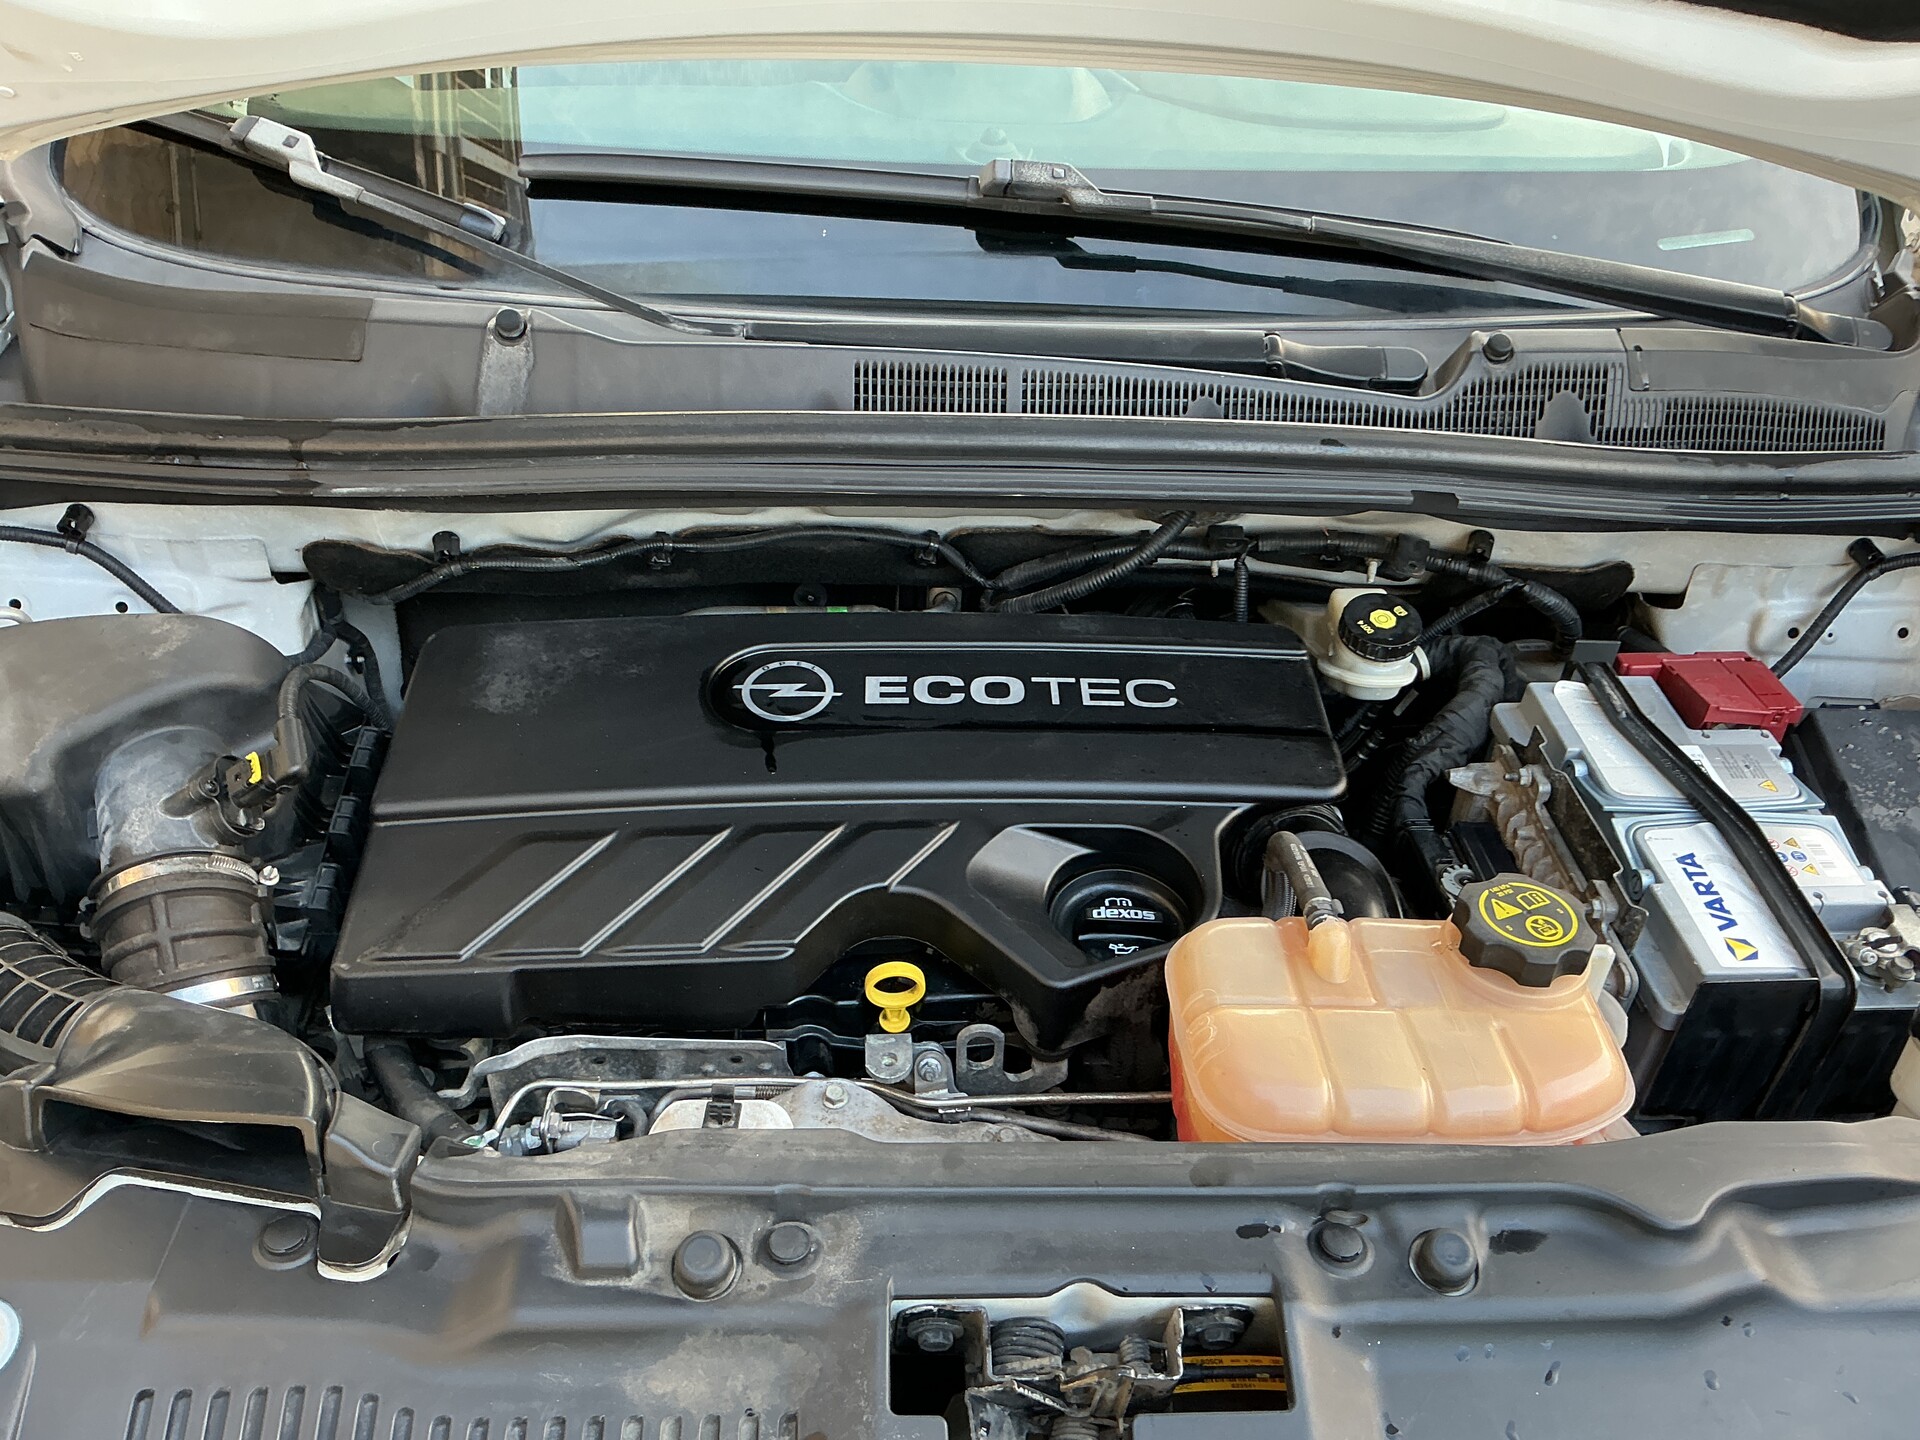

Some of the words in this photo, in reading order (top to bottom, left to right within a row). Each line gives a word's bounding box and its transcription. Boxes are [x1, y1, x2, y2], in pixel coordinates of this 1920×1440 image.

[1360, 624, 1375, 634] DOT
[761, 661, 816, 671] OPEL
[864, 675, 1178, 708] ECOTEC
[1675, 852, 1738, 932] VARTA
[1092, 906, 1156, 920] dexos
